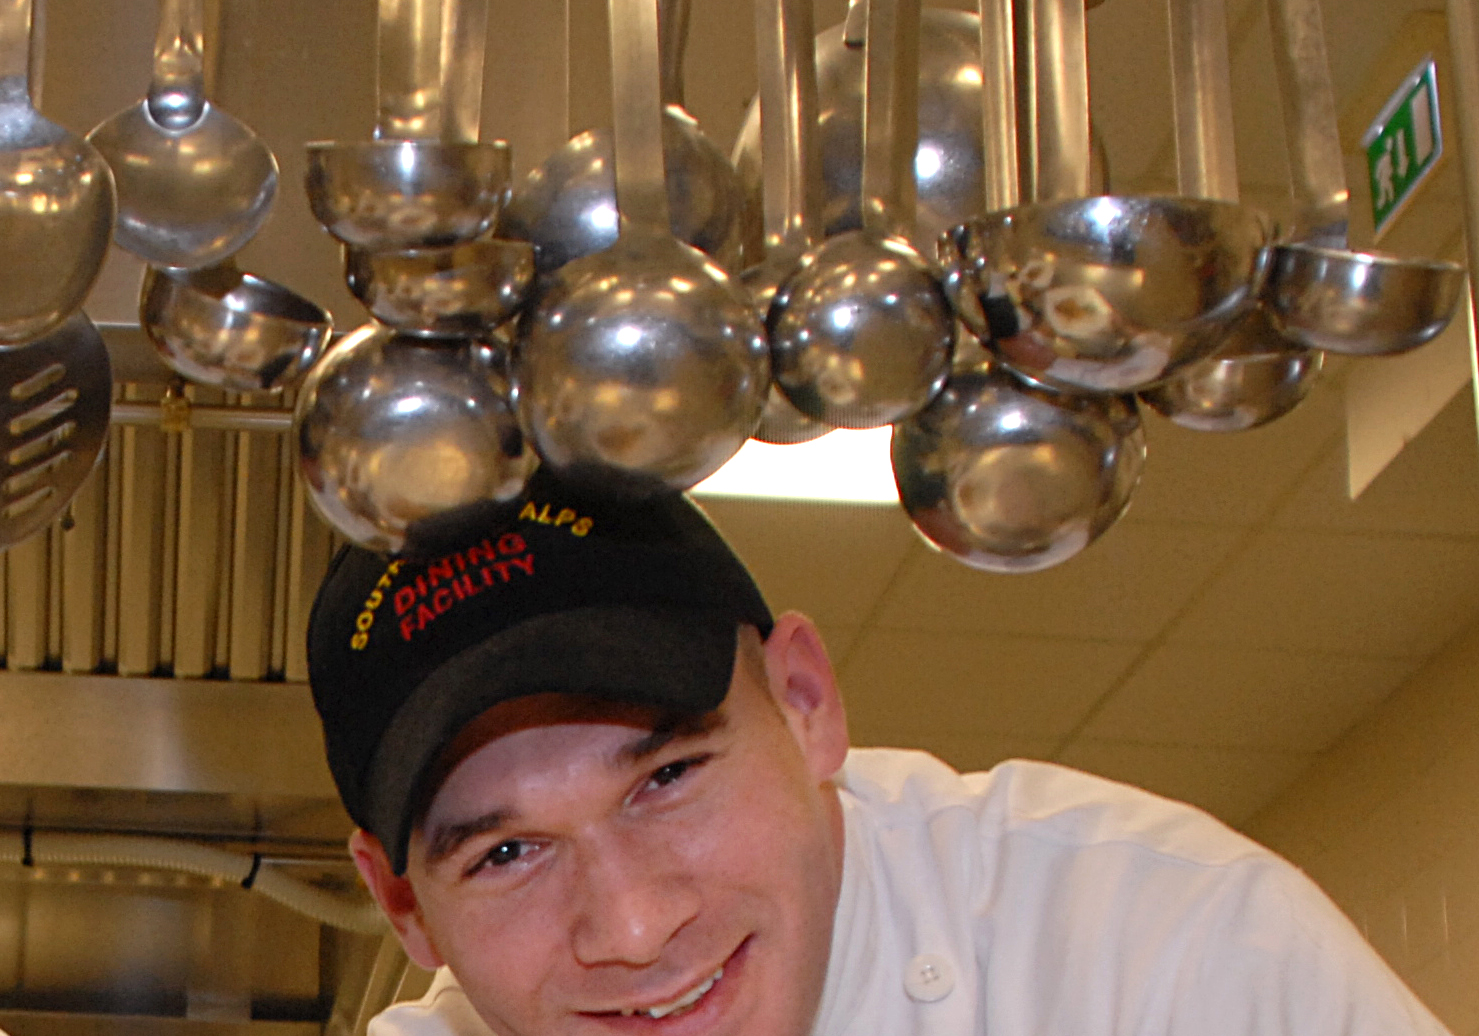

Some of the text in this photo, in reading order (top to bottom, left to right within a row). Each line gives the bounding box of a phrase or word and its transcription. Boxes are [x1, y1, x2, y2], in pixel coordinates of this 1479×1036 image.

[519, 501, 594, 537] ALPS
[394, 533, 527, 616] DINING
[399, 554, 535, 641] FACILITY
